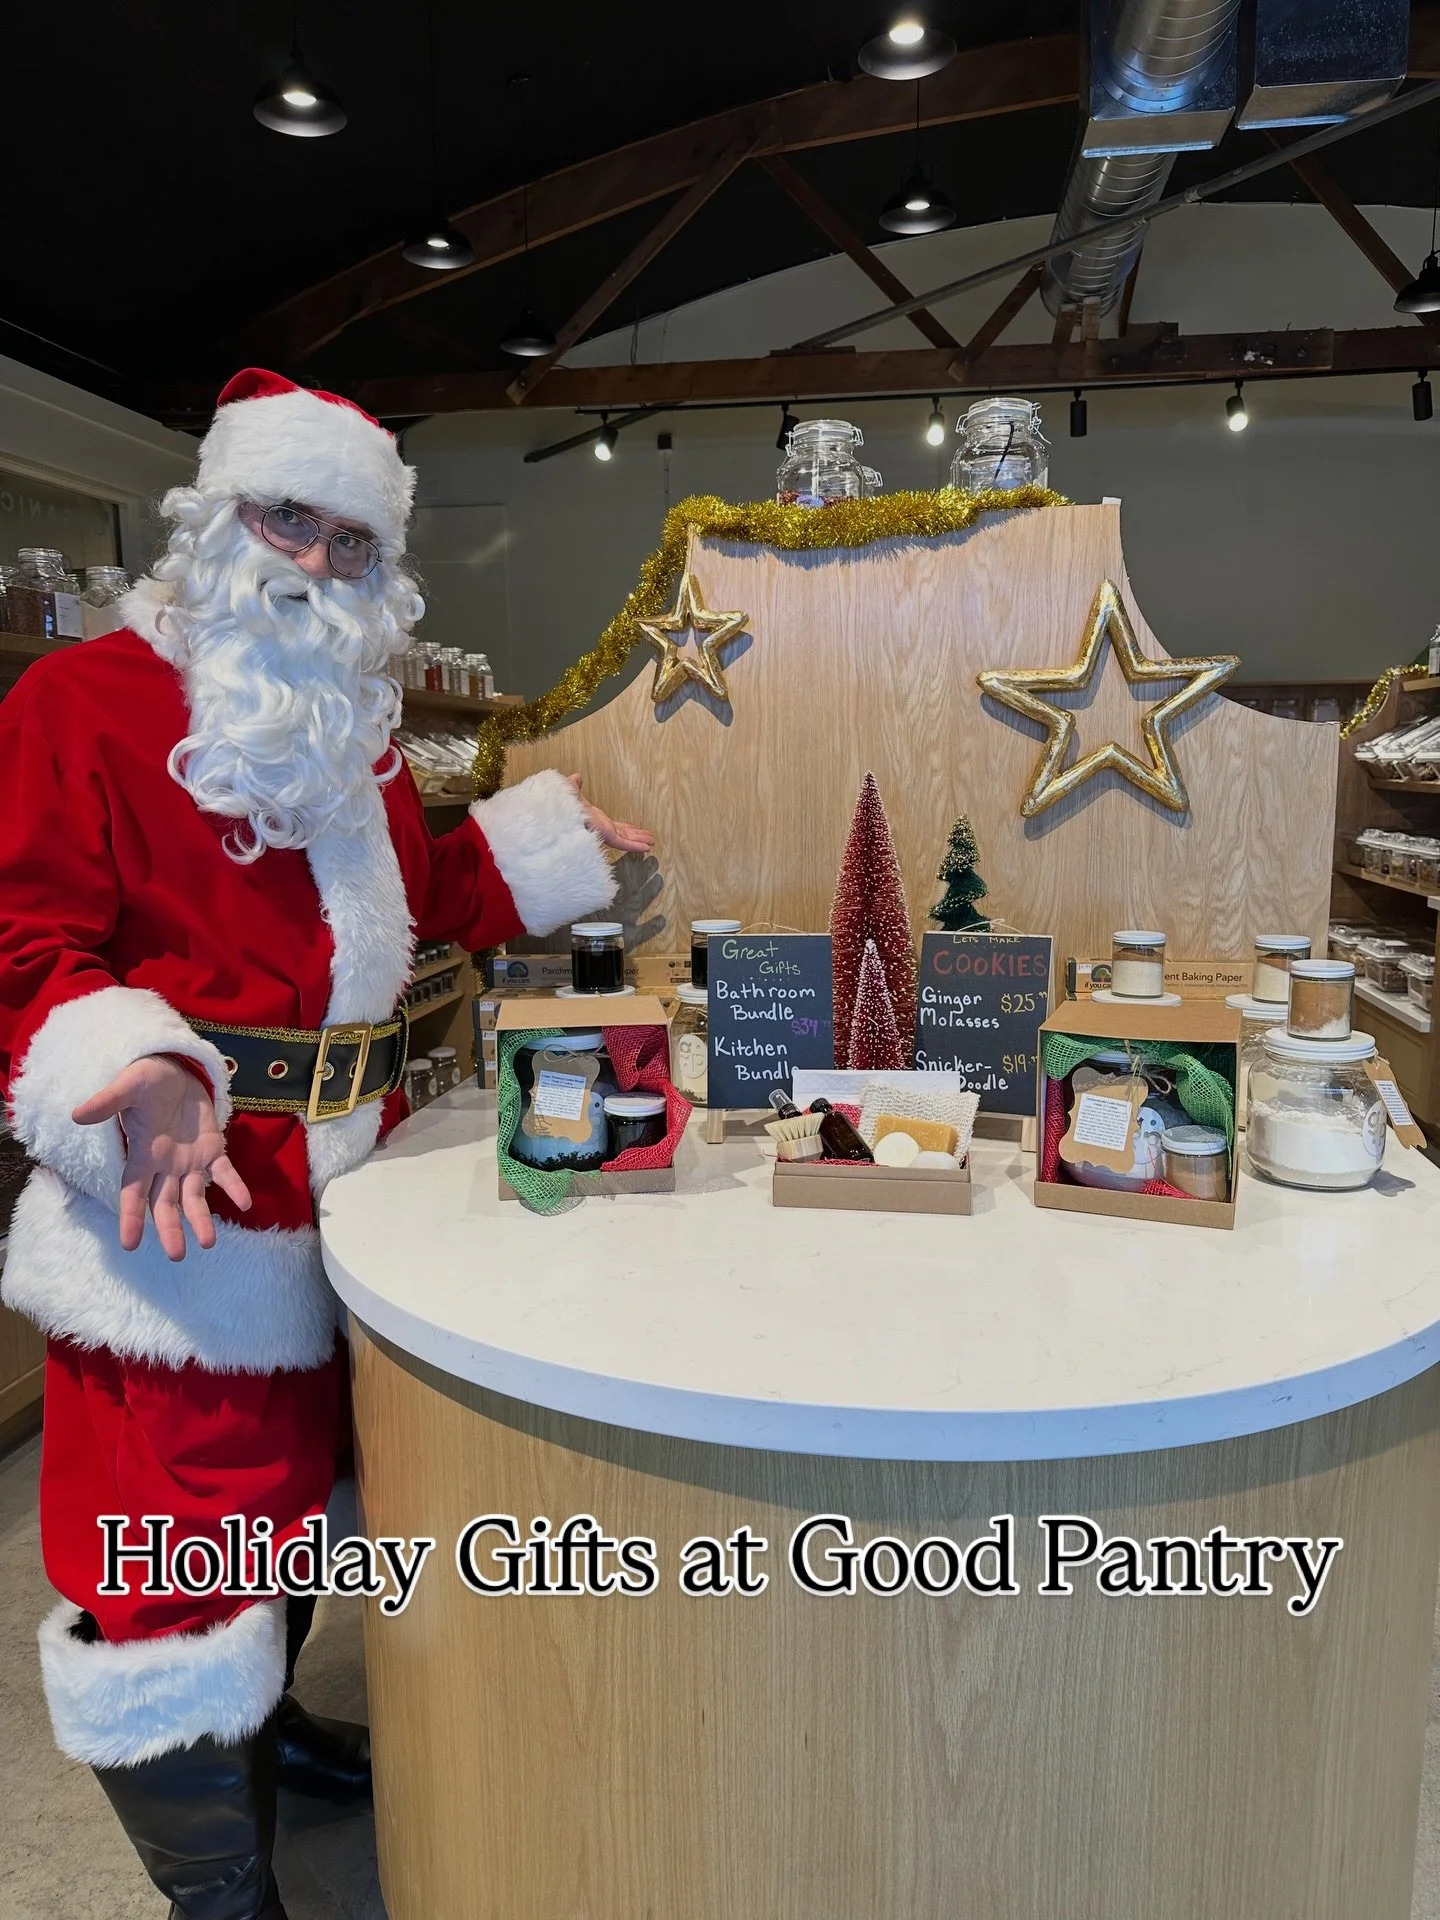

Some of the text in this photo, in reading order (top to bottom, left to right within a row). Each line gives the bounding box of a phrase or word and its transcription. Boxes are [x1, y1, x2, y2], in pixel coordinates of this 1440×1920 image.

[722, 939, 779, 960] Great
[542, 967, 571, 976] Parchm
[759, 960, 801, 975] Gifts
[933, 950, 1047, 977] COOKIES
[1182, 972, 1213, 984] Baking
[1215, 972, 1243, 983] Paper
[716, 980, 816, 999] Bathroom
[922, 986, 982, 1014] Ginger
[730, 1001, 795, 1021] Bundle
[920, 1007, 1001, 1029] Molasses
[714, 1036, 788, 1057] Kitchen
